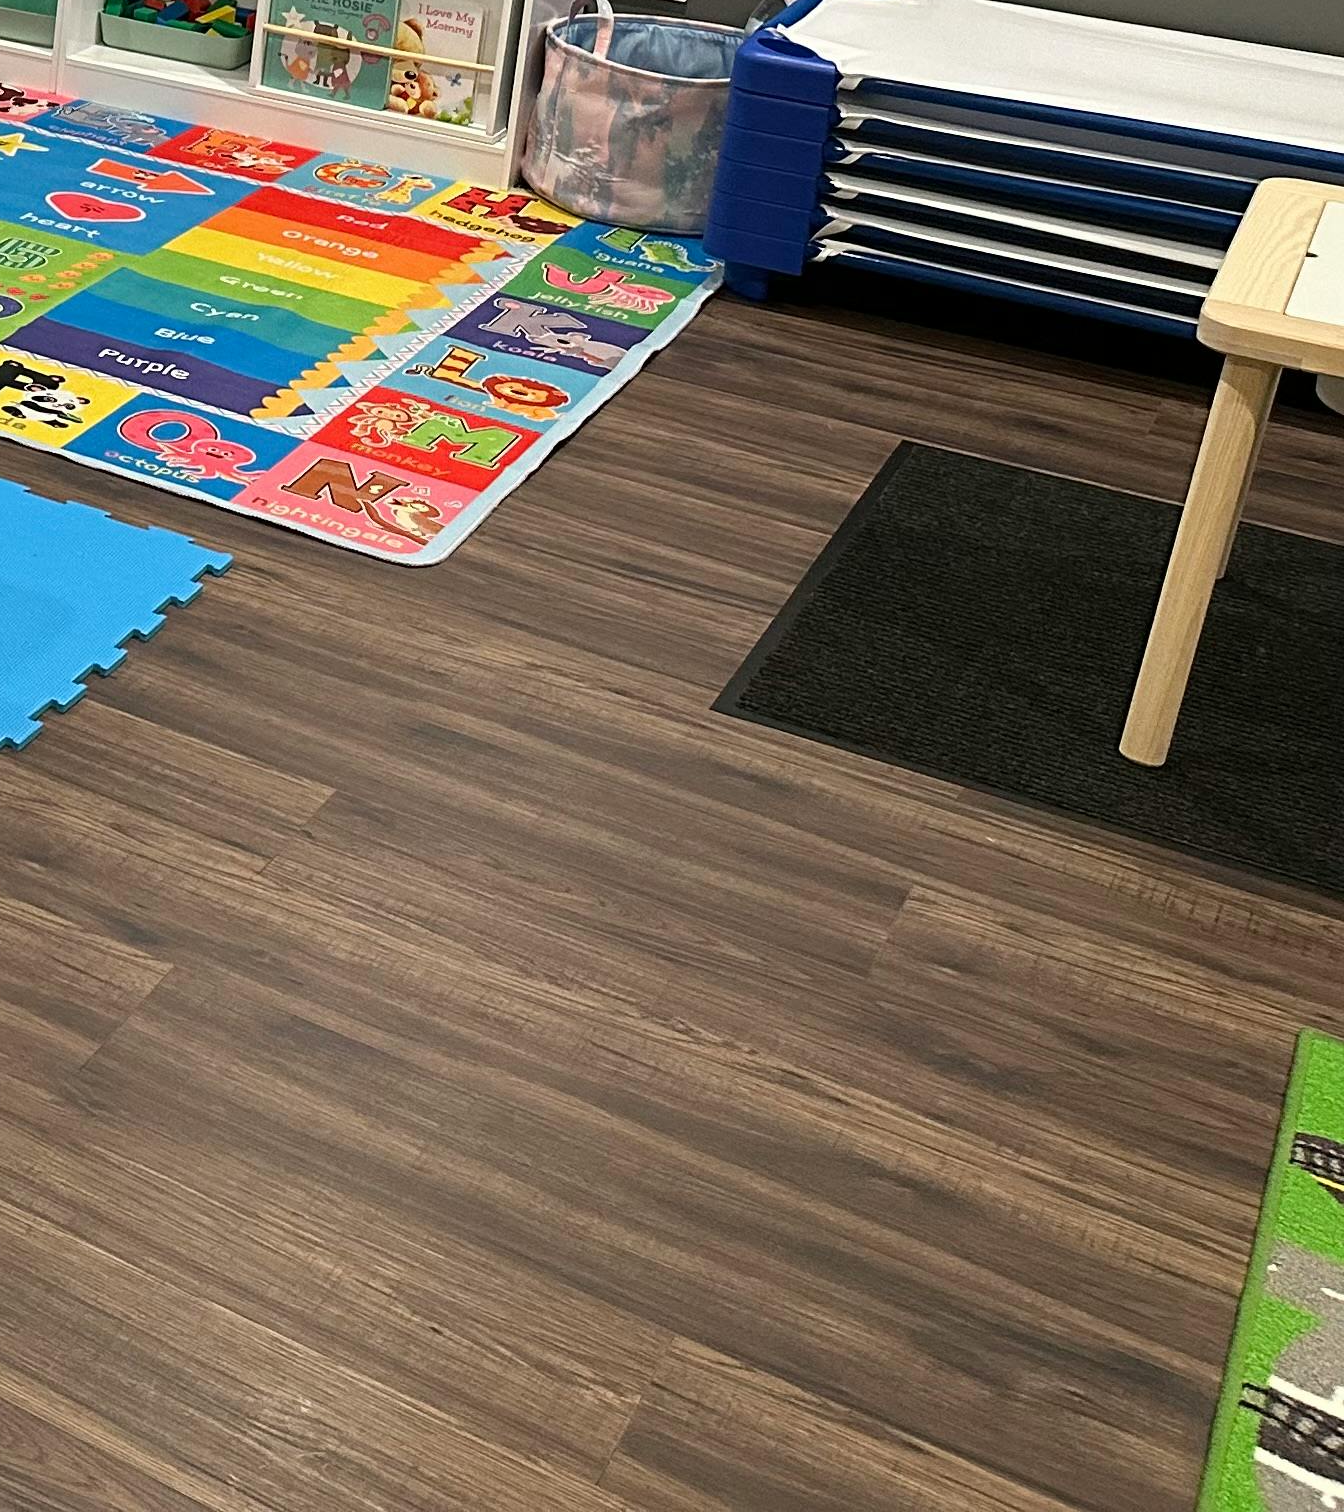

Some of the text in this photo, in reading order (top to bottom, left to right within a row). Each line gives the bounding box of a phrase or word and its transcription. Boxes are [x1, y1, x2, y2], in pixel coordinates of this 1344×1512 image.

[418, 3, 476, 26] I Love My
[425, 18, 473, 39] Mommy
[79, 180, 166, 204] arrow
[440, 186, 539, 218] H
[19, 212, 101, 239] heart
[336, 214, 390, 231] Red
[429, 210, 536, 243] hedgehog
[281, 230, 379, 260] Orange
[257, 252, 338, 280] Yellow
[593, 249, 665, 273] iguana
[219, 274, 304, 301] Green
[542, 262, 634, 295] J
[189, 302, 261, 322] Cyan
[478, 297, 588, 338] K
[527, 291, 629, 320] jellyfish
[154, 327, 216, 346] Blue
[98, 348, 190, 381] Purple
[116, 409, 221, 454] O
[399, 411, 523, 470] M
[103, 449, 201, 484] octopus
[350, 442, 454, 478] monkey
[280, 458, 412, 514] N
[252, 496, 405, 550] nightingale
